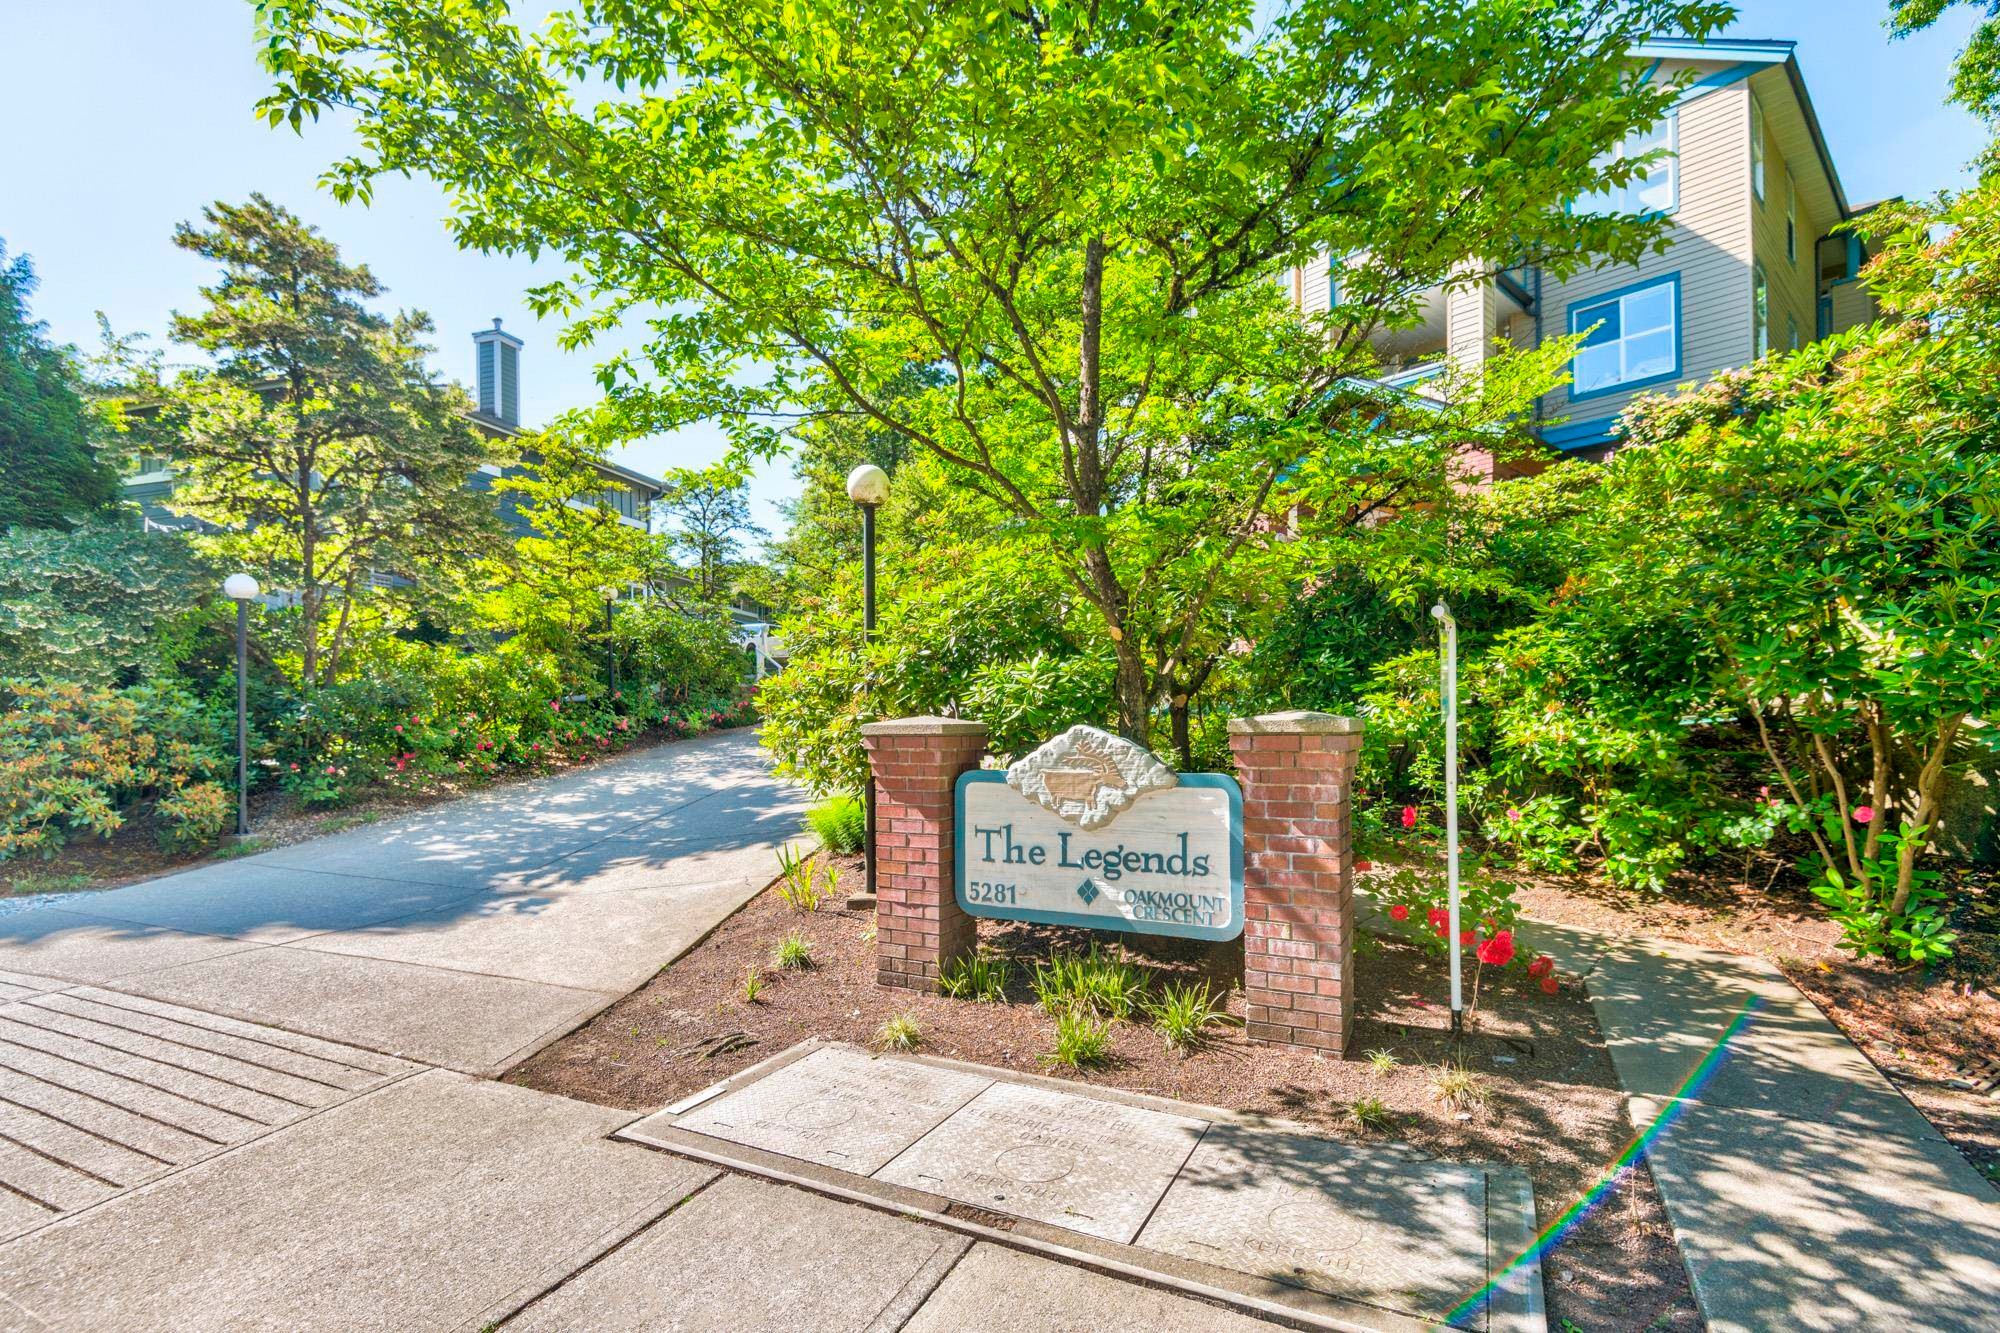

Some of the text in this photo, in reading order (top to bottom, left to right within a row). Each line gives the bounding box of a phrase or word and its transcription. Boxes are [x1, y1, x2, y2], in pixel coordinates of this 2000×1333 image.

[975, 824, 1210, 880] The Legends
[969, 881, 1016, 904] 5281
[1124, 889, 1225, 912] OAKMOUNT
[1132, 904, 1214, 926] CRESCENT
